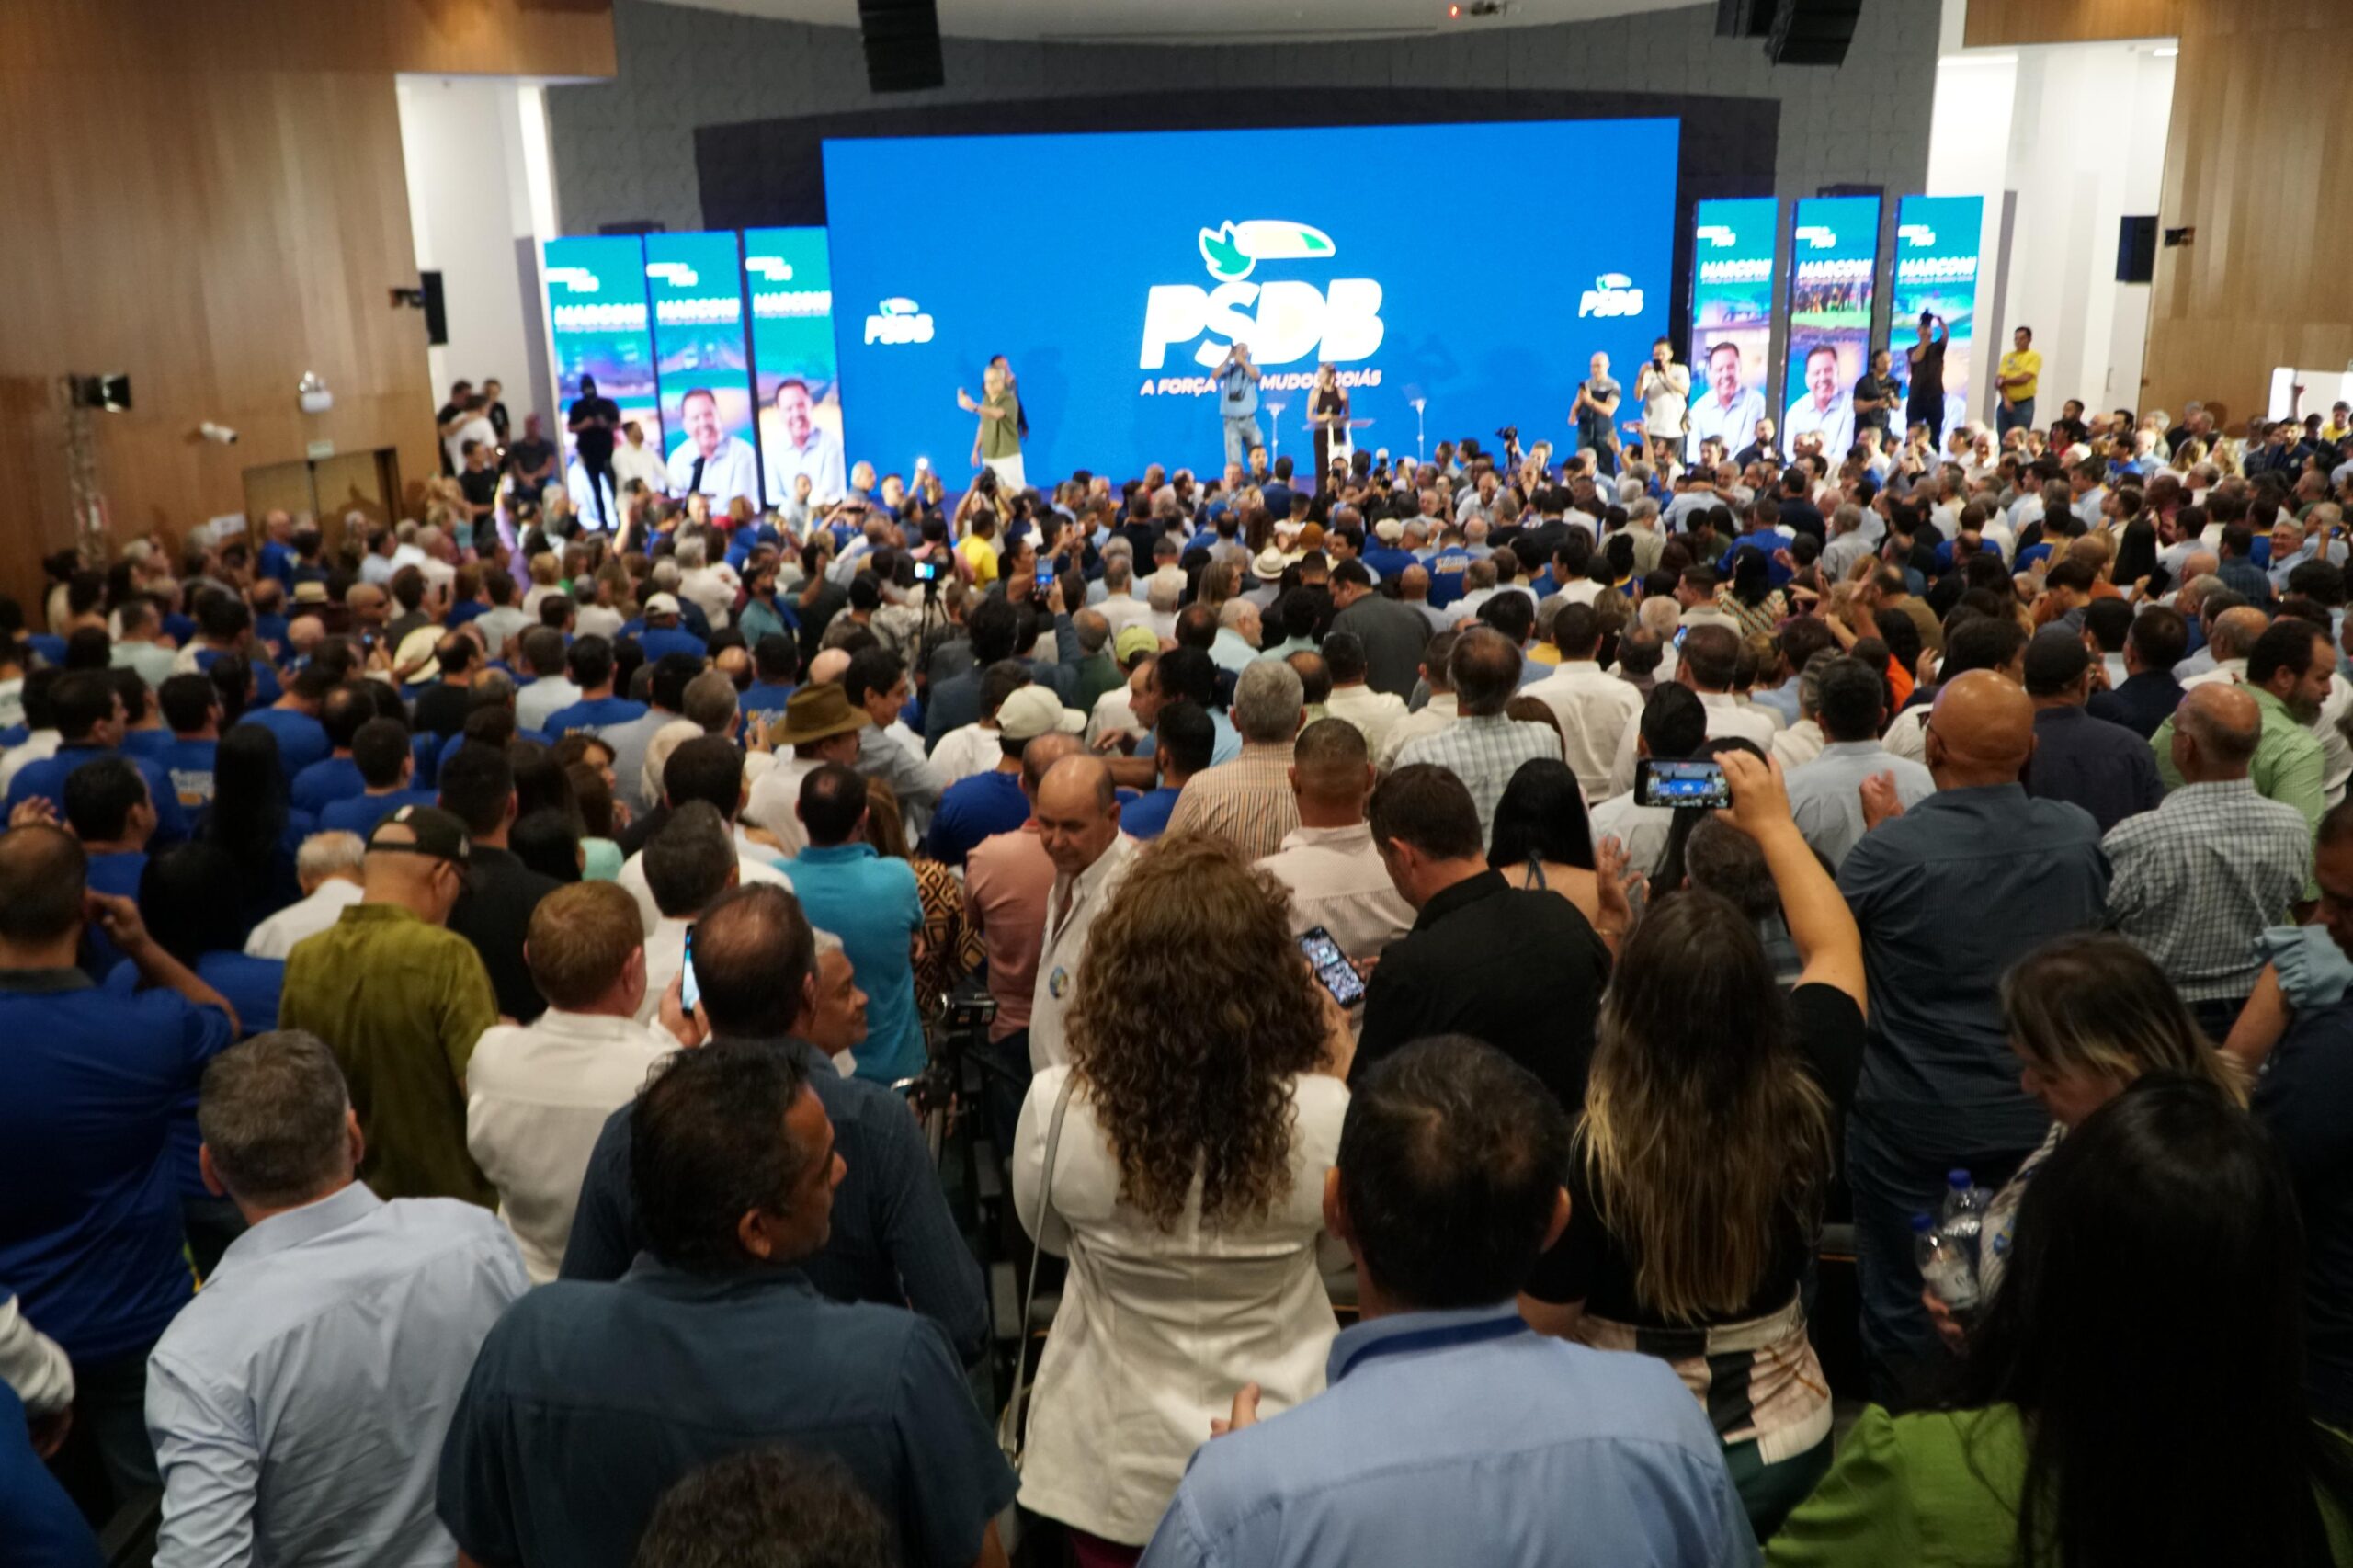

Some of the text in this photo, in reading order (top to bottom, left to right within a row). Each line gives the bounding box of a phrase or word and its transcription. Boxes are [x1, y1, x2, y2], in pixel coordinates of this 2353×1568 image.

[1700, 258, 1773, 279] MARCONI
[1798, 258, 1873, 279] MARCONI
[1898, 256, 1977, 278] MARCONI
[1578, 289, 1643, 317] PSDB
[864, 313, 934, 345] PSDB
[1140, 278, 1384, 369] PSDB
[1140, 379, 1154, 396] A
[1157, 376, 1217, 397] FORÇA
